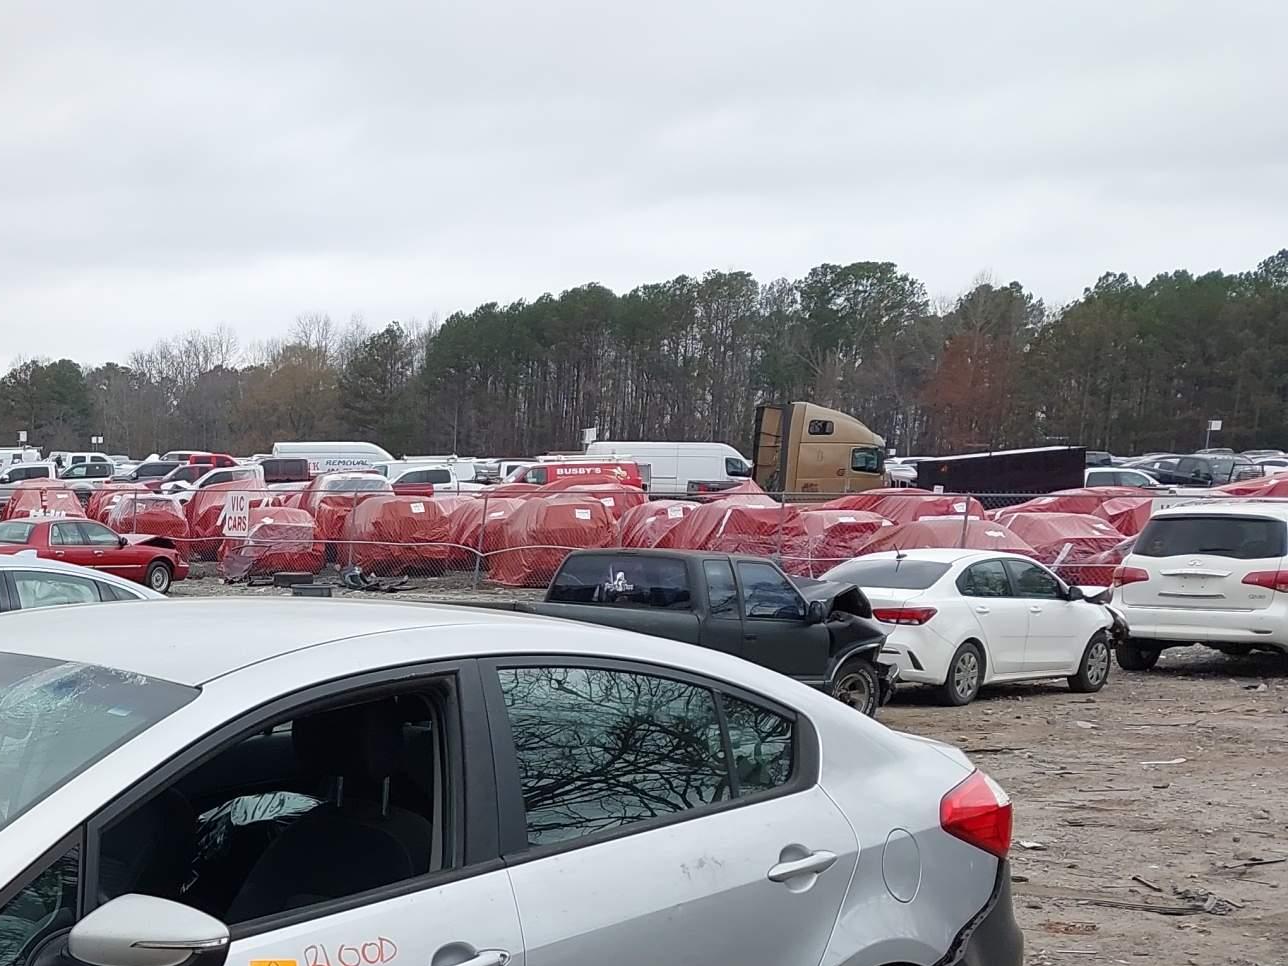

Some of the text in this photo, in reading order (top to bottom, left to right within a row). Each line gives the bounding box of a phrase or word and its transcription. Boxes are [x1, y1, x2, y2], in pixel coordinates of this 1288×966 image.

[556, 467, 602, 475] BUSBY'S
[232, 496, 244, 512] VIC
[227, 516, 247, 531] CARS
